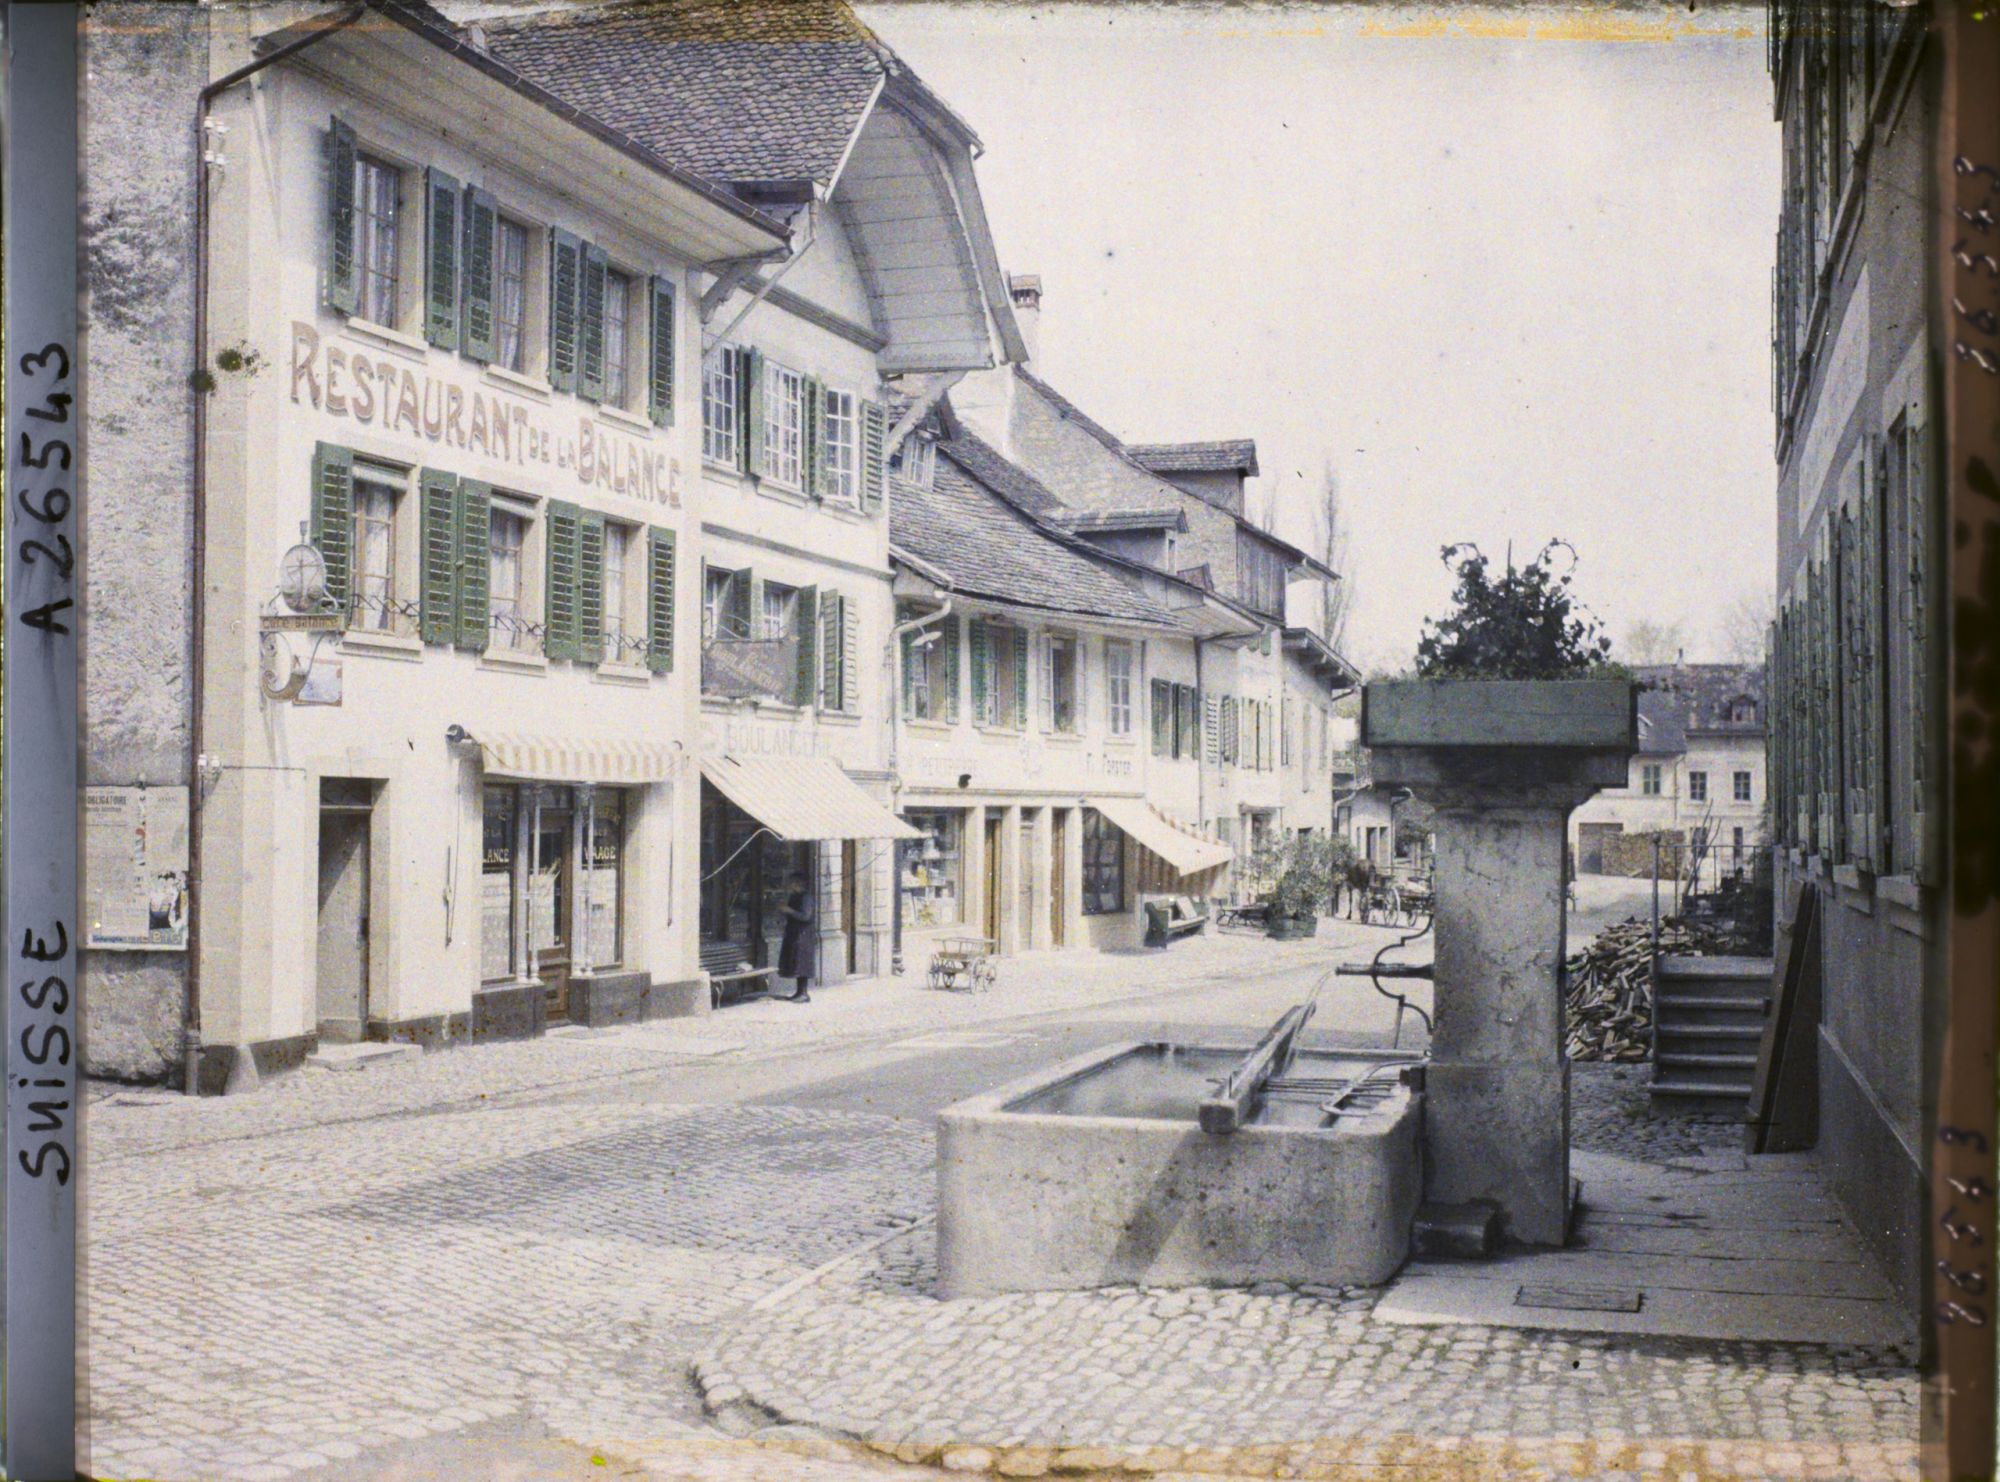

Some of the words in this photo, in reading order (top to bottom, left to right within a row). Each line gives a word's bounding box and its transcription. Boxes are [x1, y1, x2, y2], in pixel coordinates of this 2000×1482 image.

[19, 342, 73, 578] 26543
[290, 320, 528, 466] RESTAURANT
[529, 426, 550, 464] DE
[557, 436, 578, 471] LA
[577, 415, 682, 510] BALANCE
[19, 597, 73, 636] A
[483, 848, 510, 863] LANCE
